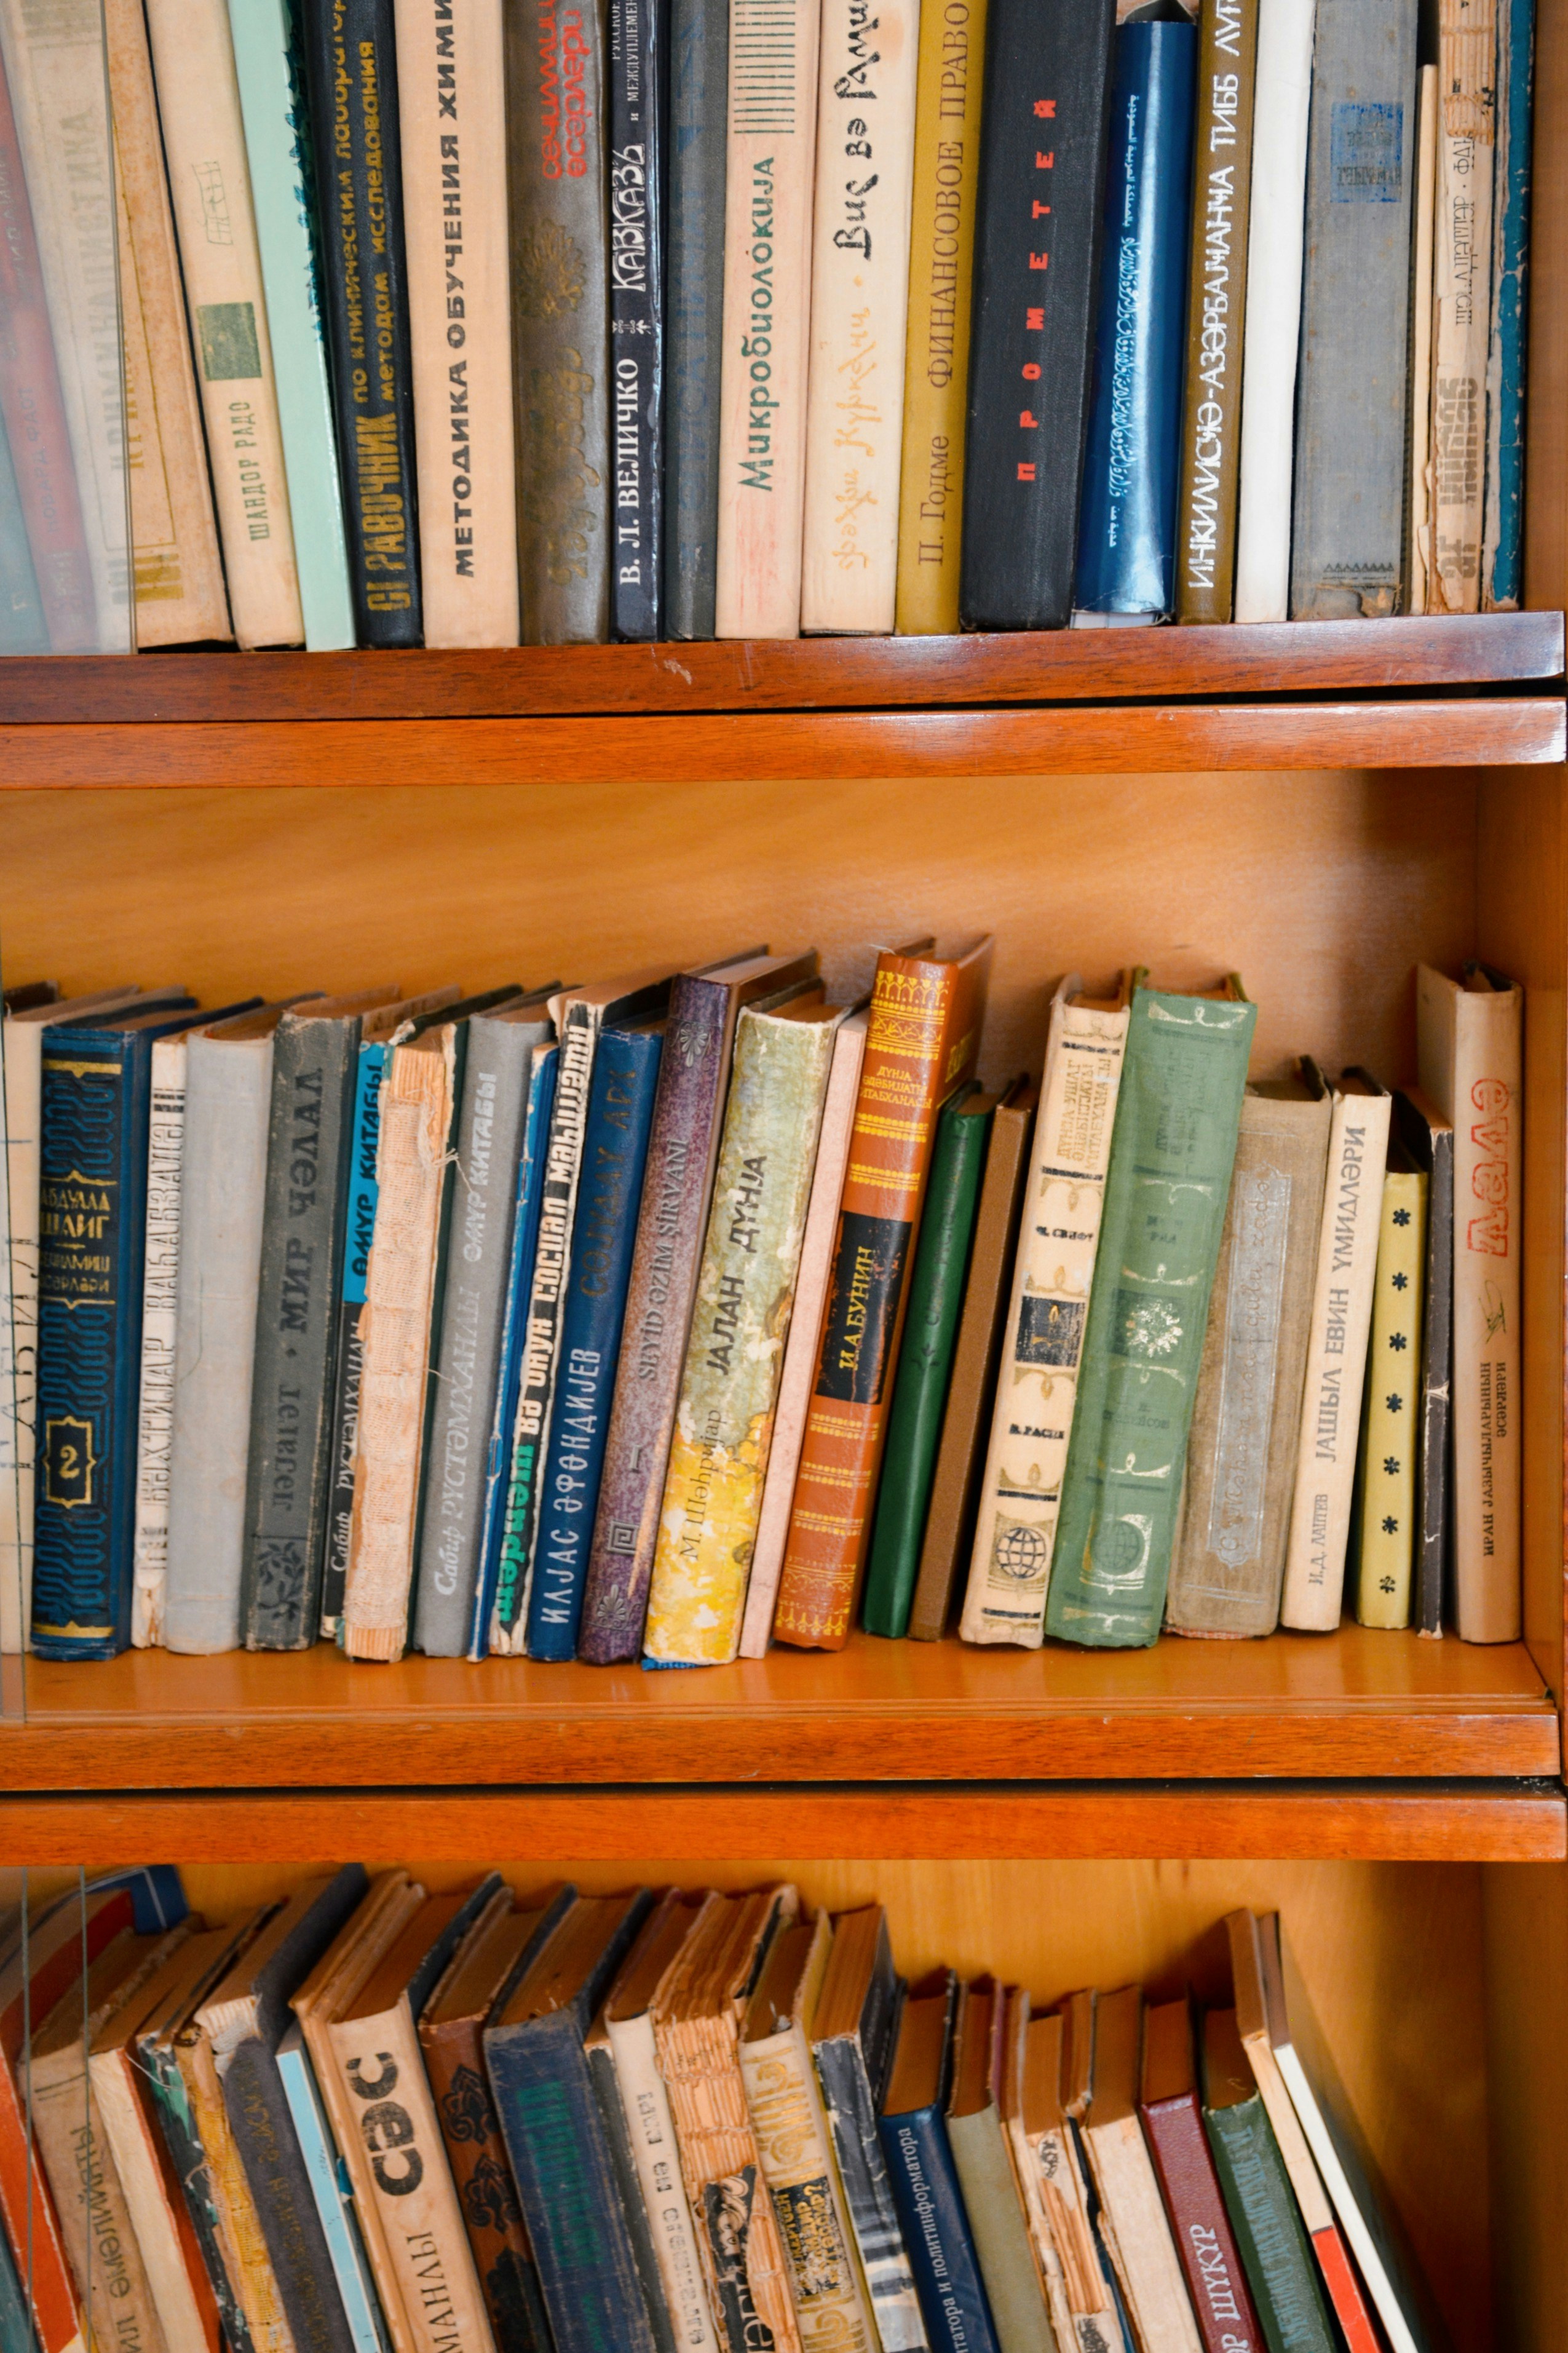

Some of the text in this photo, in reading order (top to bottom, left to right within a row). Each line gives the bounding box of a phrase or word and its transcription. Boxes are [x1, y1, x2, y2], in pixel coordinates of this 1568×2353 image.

[1209, 72, 1239, 152] ТИББ
[336, 170, 366, 359] клиническим
[358, 41, 395, 401] методам исследования
[440, 134, 466, 349] ОБУЧЕНИЯ
[918, 1, 970, 566] П. Годме ФИНАНСОВОЕ ПРАВО
[1016, 98, 1057, 482] ПРОМЕТЕЙ
[352, 369, 368, 403] по
[228, 401, 270, 541] ШАНДОР РАДО
[447, 359, 474, 578] МЕТОДИКА
[616, 358, 641, 585] В. Л. ВЕЛИЧКО
[858, 1088, 932, 1109] ИТАБХАНАСЫ
[40, 1213, 110, 1240] ШАИГ
[279, 1239, 312, 1334] МИР
[1323, 1288, 1350, 1354] ЕВИН
[433, 1525, 467, 1596] Сабир
[469, 1073, 497, 1186] КИТАБЫ
[526, 1317, 553, 1388] онун
[519, 1399, 543, 1436] вә
[552, 1347, 601, 1514] ӘФӘНДИЈЕВ
[679, 1531, 703, 1560] М.
[706, 1275, 746, 1376] ЈАЛАН
[1315, 1367, 1342, 1462] ЈАШЫЛ
[1495, 1362, 1508, 1438] ӘСӘРЛӘРИ
[59, 1445, 80, 1479] 2
[1310, 1494, 1329, 1547] ЛАПТЕВ
[1482, 1514, 1494, 1557] ИРАН
[540, 1529, 579, 1624] ИЛЈАС
[346, 2051, 424, 2197] СӘС
[895, 2127, 950, 2277] политинформатора
[936, 2282, 952, 2293] и
